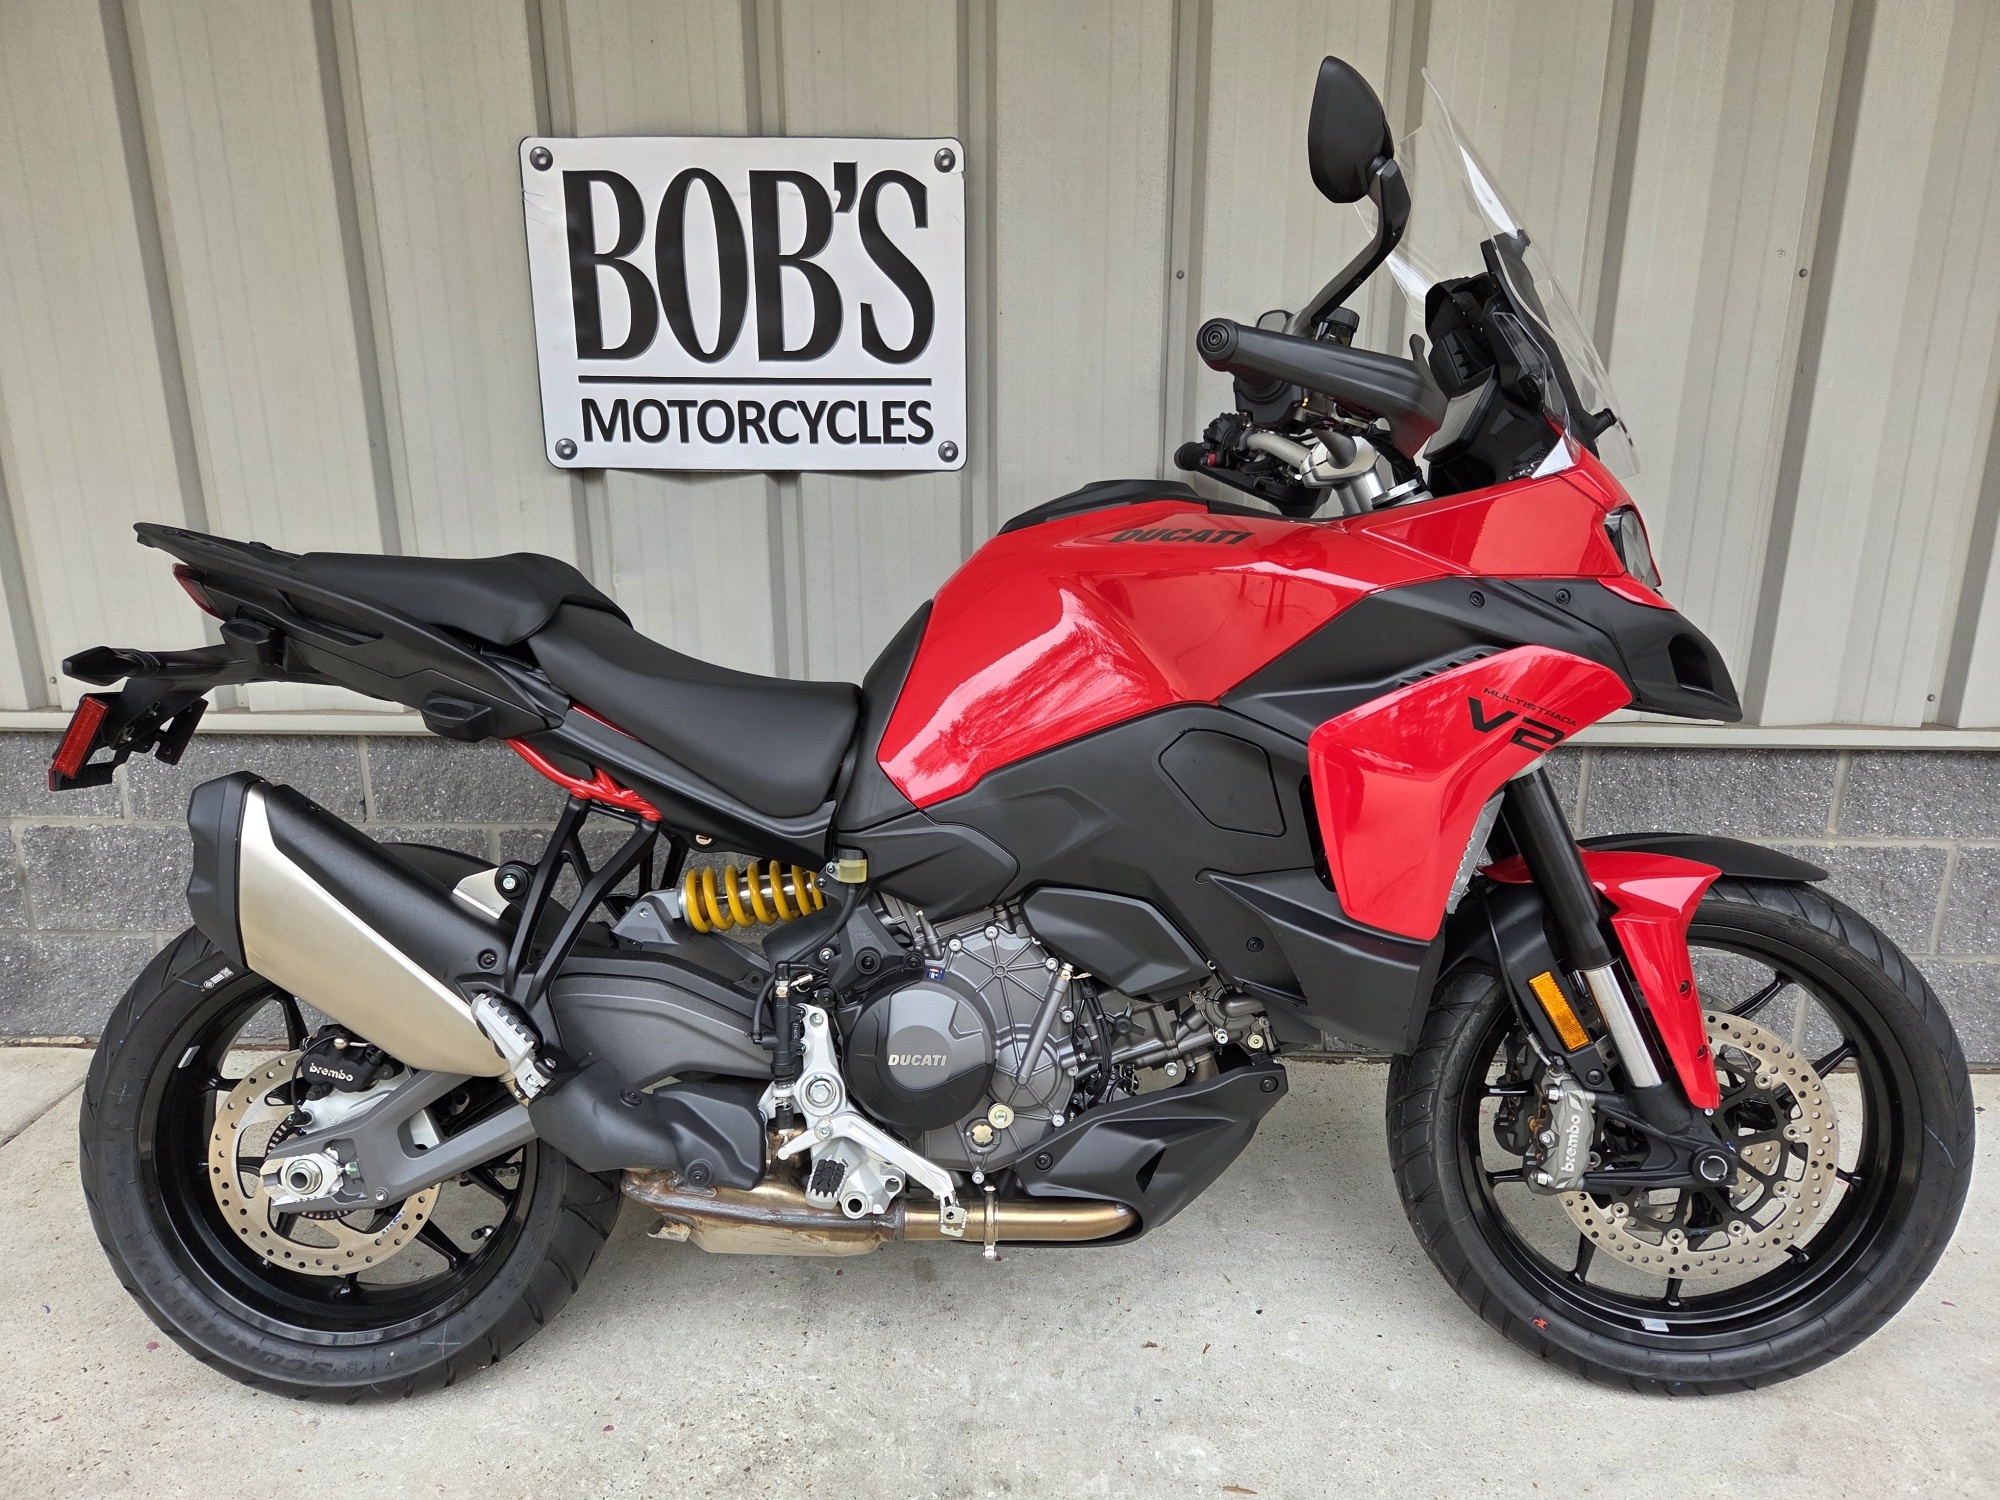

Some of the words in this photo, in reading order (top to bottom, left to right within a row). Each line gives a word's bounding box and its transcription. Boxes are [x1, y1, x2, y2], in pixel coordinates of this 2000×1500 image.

[562, 161, 935, 364] BOB'S
[581, 398, 934, 445] MOTORCYCLES
[1108, 528, 1256, 545] DUCATI
[1467, 696, 1566, 754] V2
[1483, 687, 1577, 727] MULTISTRADA
[309, 1062, 354, 1082] brembo
[887, 1054, 947, 1066] DUCATI
[1560, 1114, 1581, 1172] brembo
